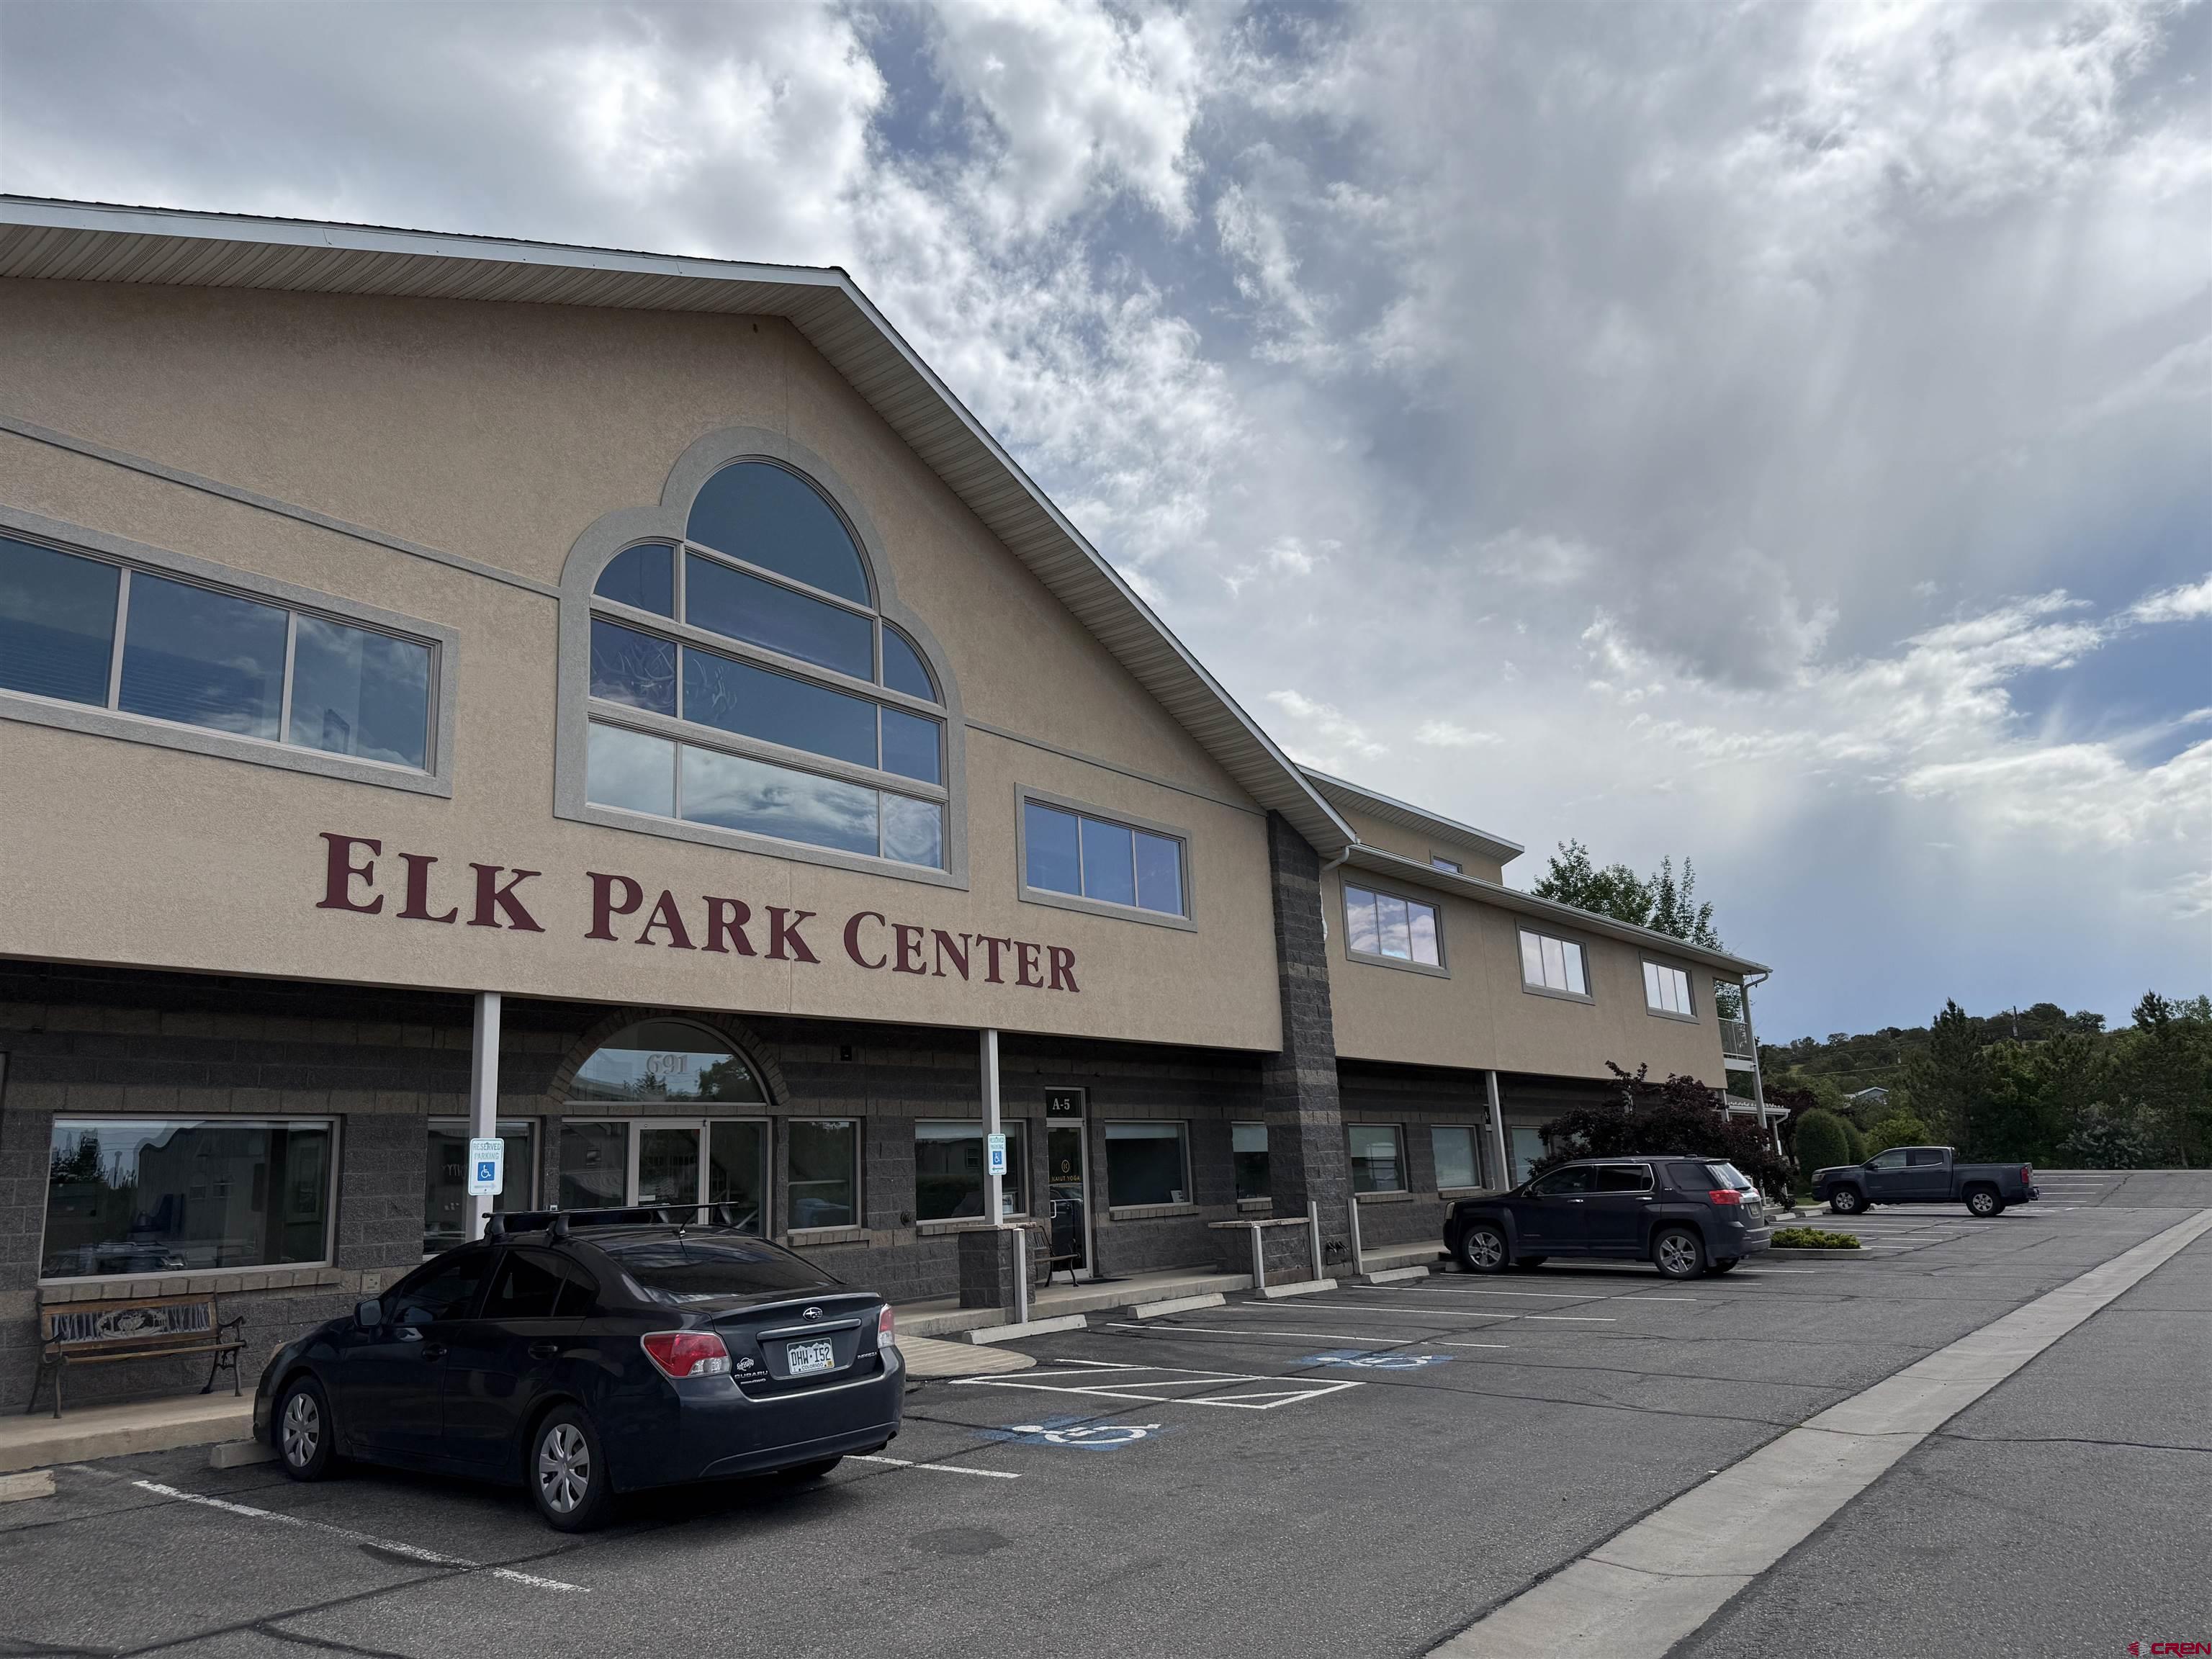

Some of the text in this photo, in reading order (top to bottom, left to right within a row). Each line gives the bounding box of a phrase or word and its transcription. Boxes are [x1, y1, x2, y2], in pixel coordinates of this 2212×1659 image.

[316, 832, 1080, 992] ELK PARK CENTER
[646, 1053, 689, 1074] 691
[1052, 1097, 1071, 1110] A-5
[734, 1370, 768, 1379] SUBARU
